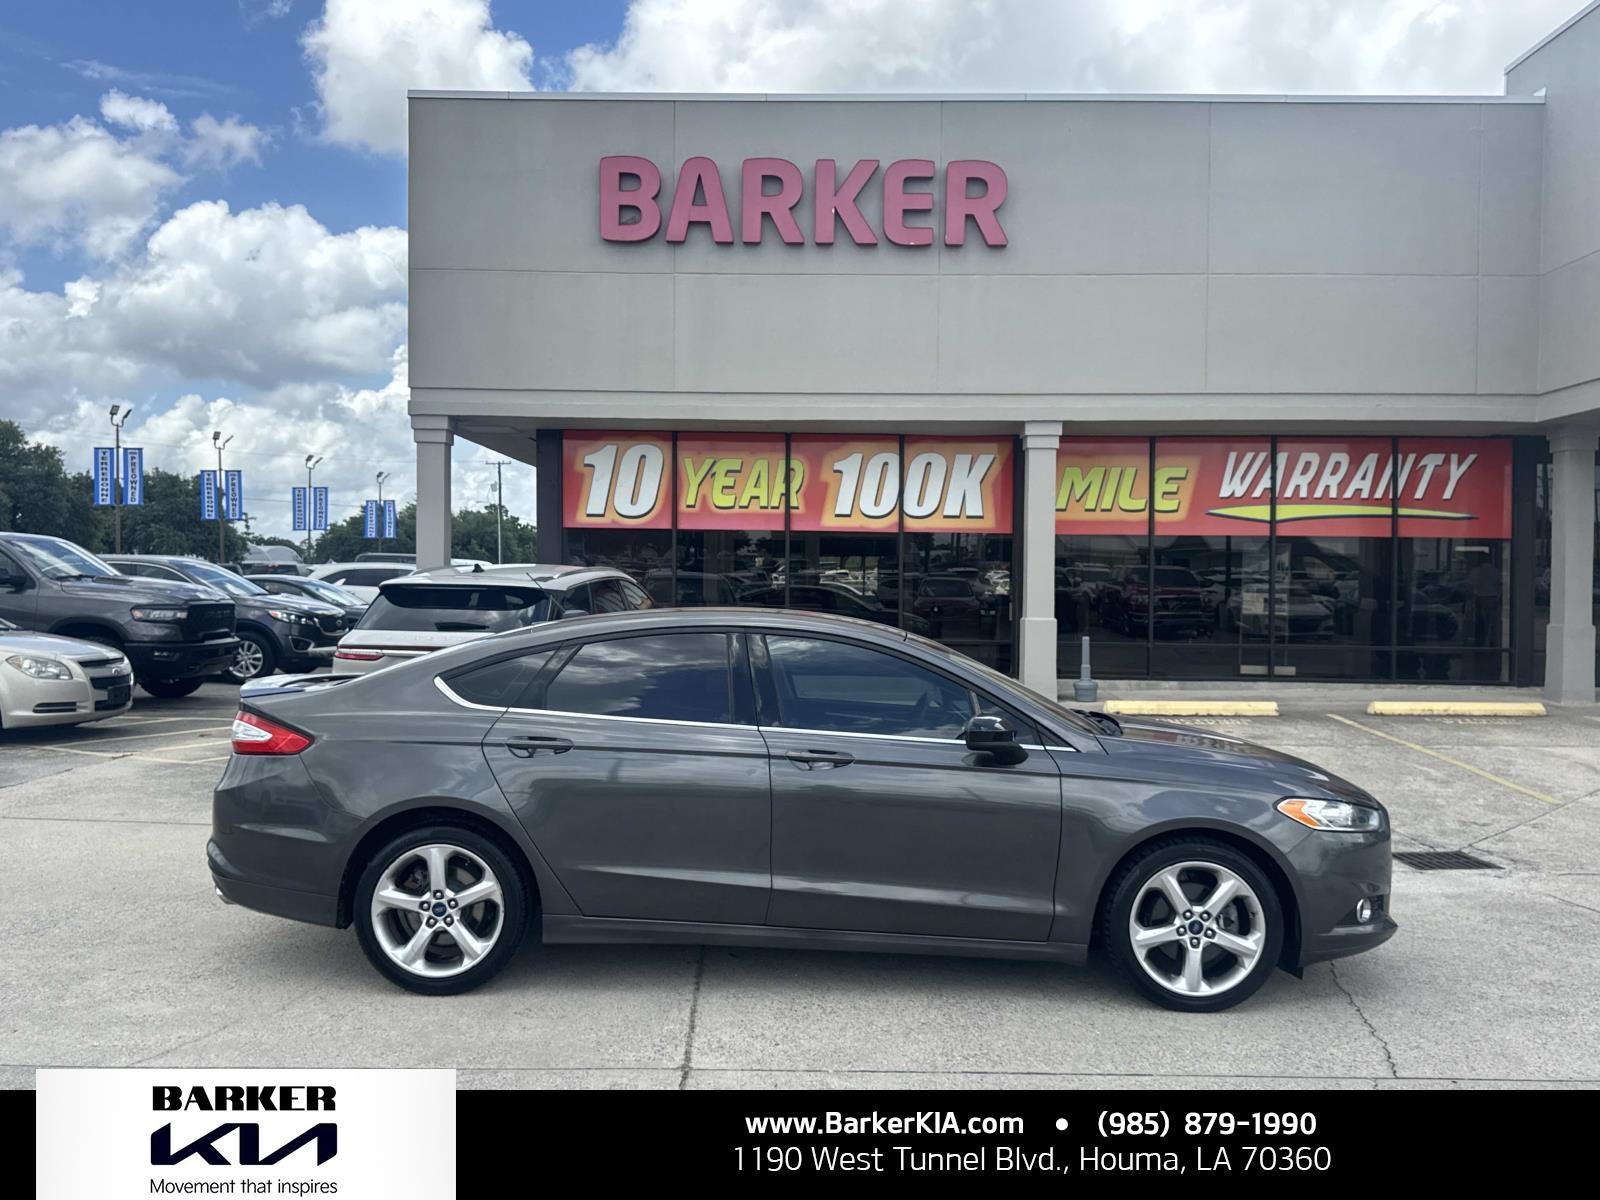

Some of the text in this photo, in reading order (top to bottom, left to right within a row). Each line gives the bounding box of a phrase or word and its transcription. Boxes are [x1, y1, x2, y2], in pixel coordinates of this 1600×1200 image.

[599, 155, 1008, 247] BARKER
[583, 443, 1478, 519] 10 YEAR 100K MILE WARRANTY
